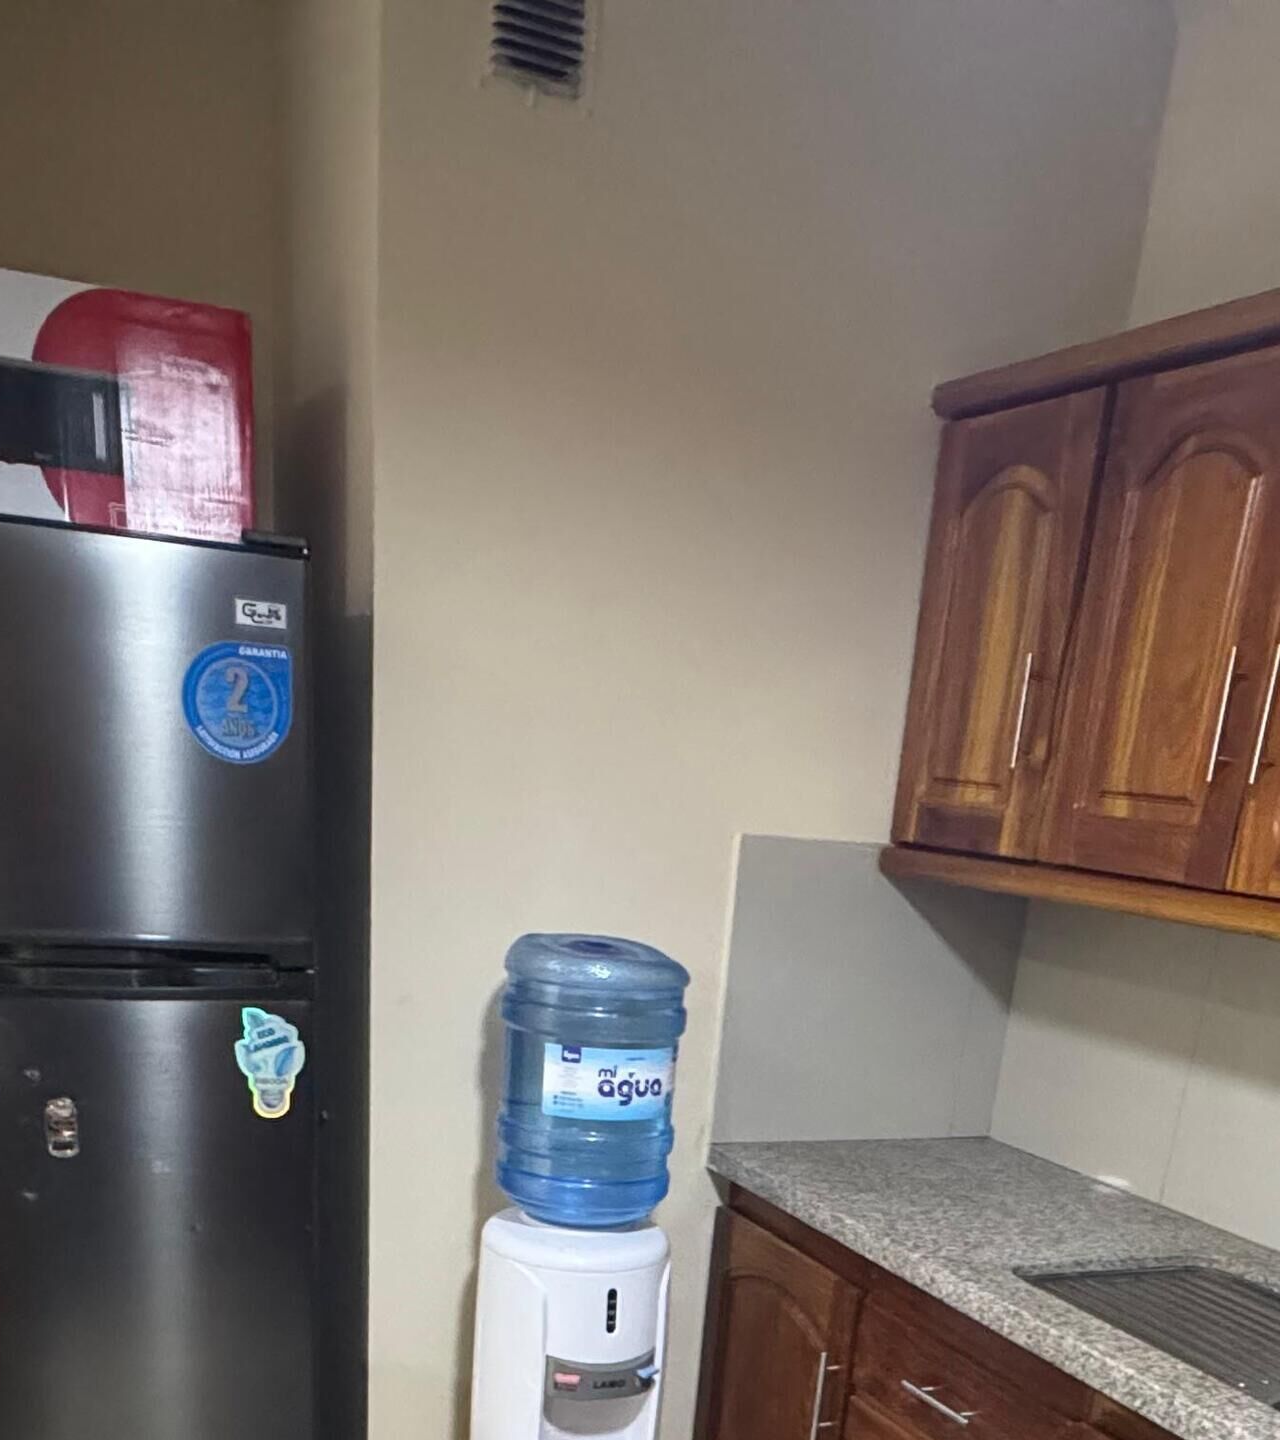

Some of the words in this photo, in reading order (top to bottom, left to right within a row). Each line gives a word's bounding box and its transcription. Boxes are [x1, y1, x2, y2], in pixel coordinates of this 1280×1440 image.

[225, 666, 250, 714] 2
[598, 1065, 618, 1078] mi
[598, 1079, 662, 1107] agua
